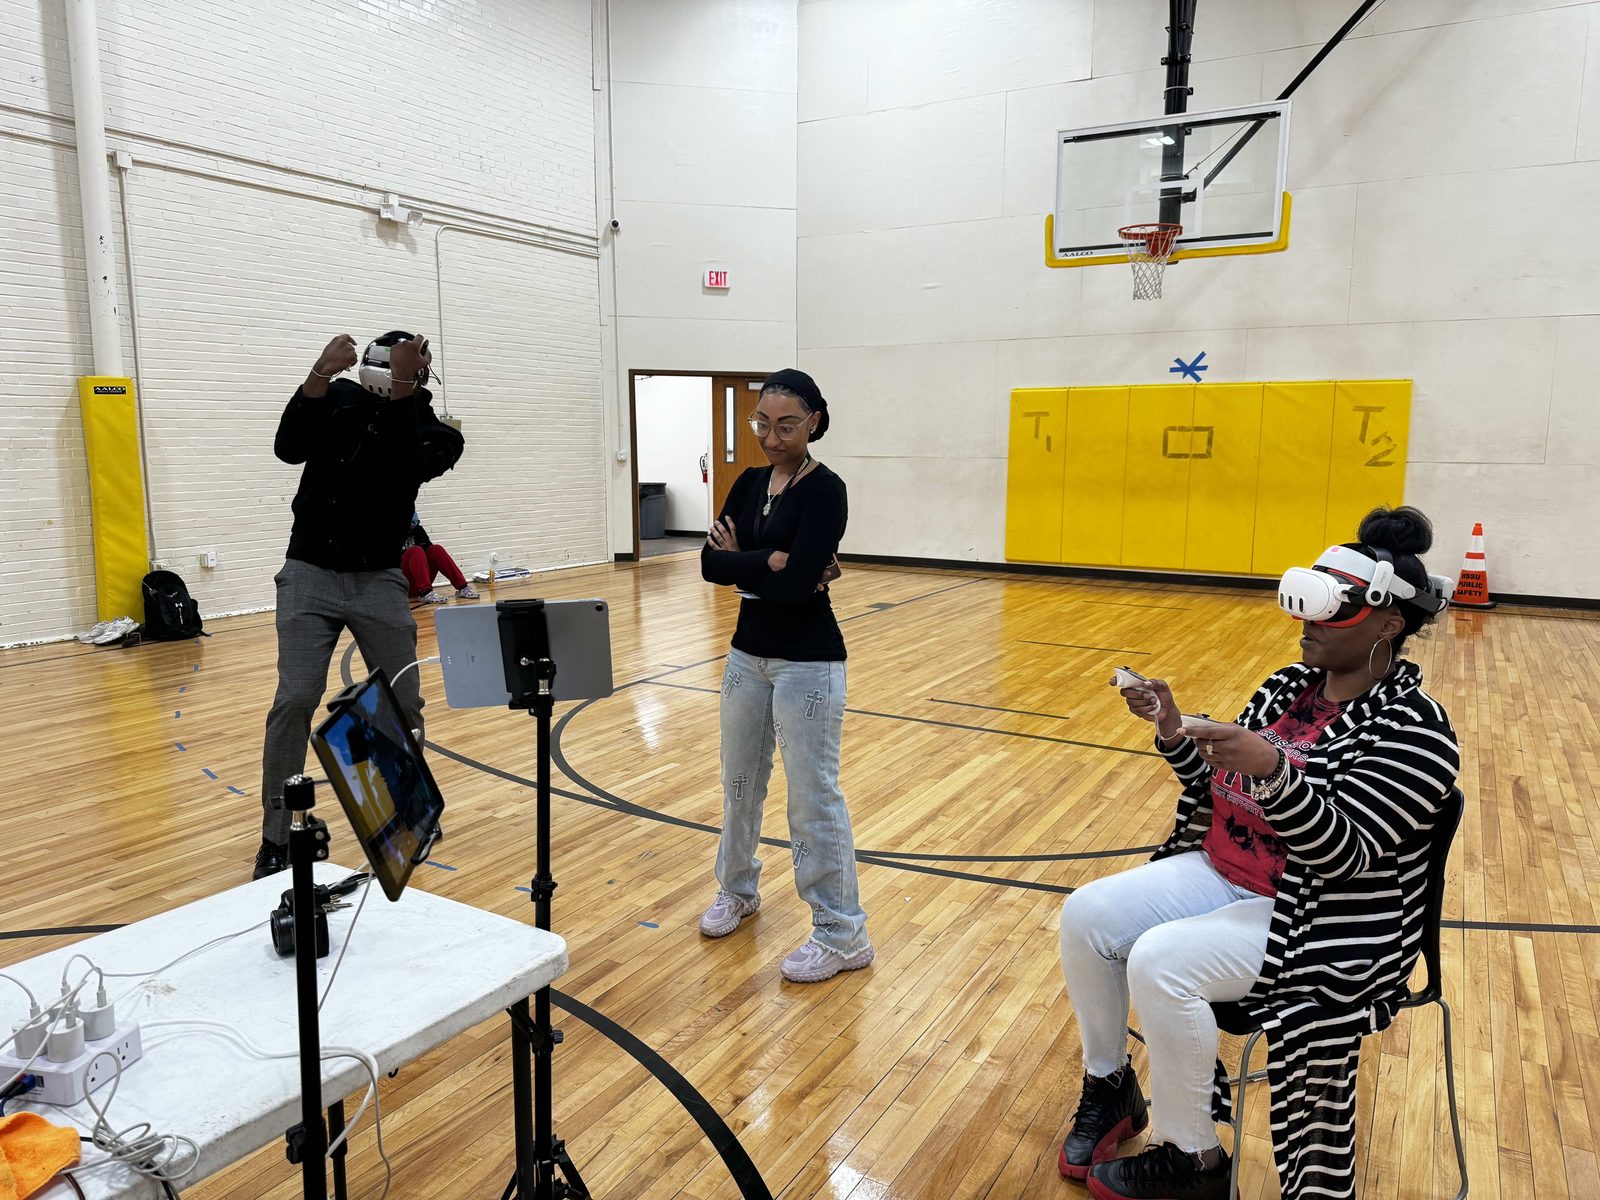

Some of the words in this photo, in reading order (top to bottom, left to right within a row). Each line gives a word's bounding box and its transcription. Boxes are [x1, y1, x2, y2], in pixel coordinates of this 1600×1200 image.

[708, 270, 728, 287] EXIT
[1458, 581, 1483, 589] PUBLIC
[1456, 589, 1483, 597] SAFETY
